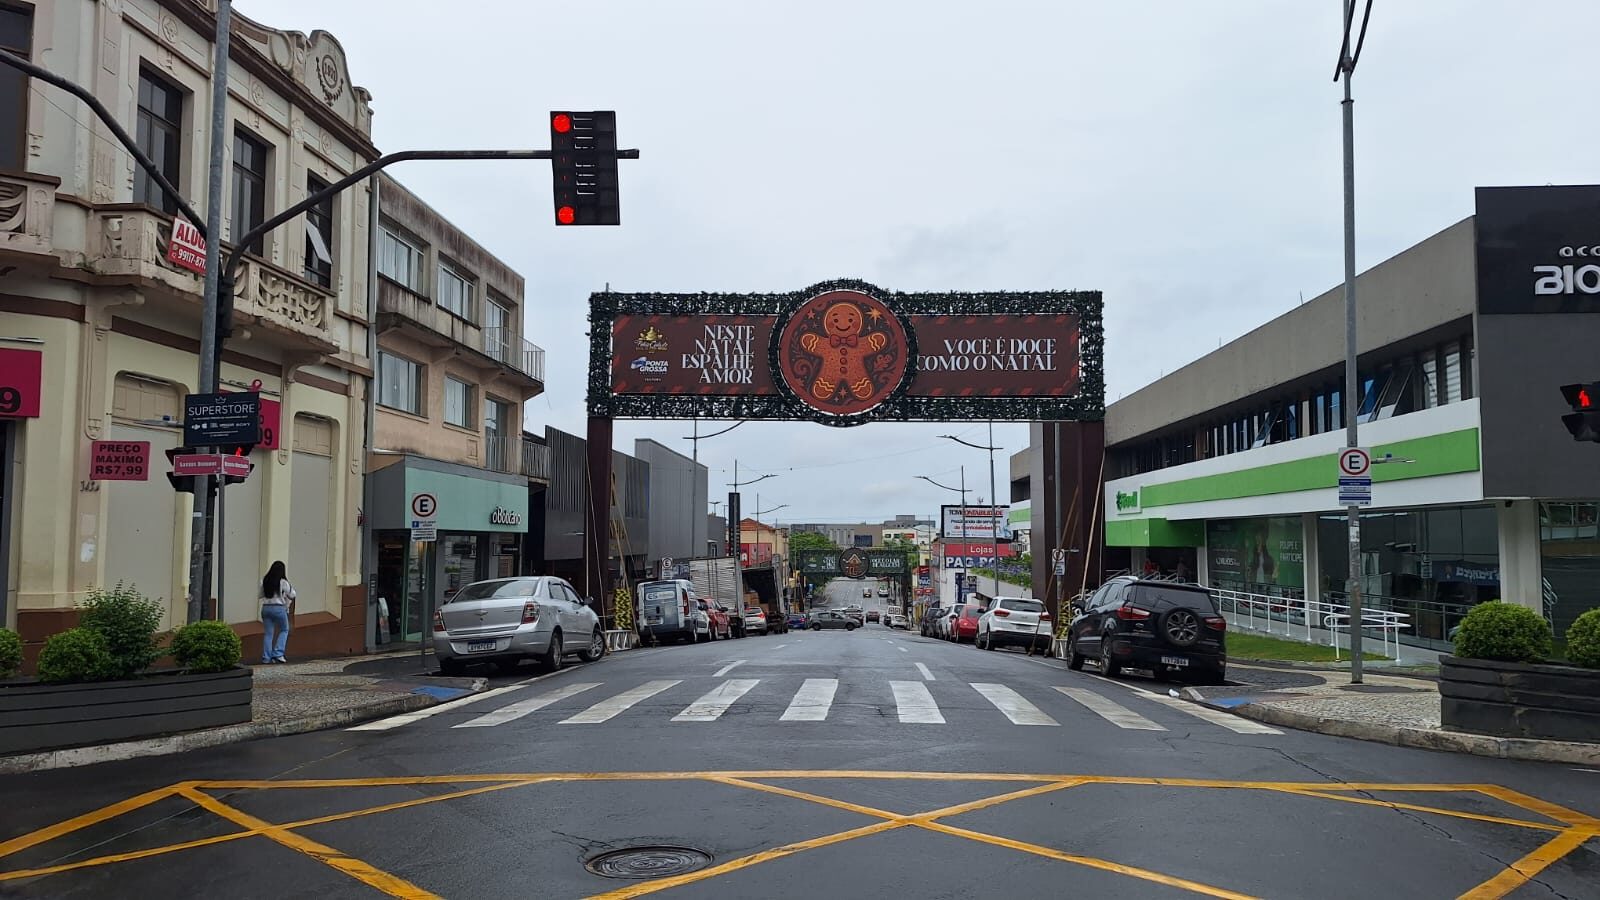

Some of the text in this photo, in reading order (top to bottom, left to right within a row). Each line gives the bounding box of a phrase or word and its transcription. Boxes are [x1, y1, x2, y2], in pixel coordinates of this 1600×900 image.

[176, 224, 206, 251] ALUG
[704, 325, 755, 340] NESTE
[695, 340, 755, 354] NATAL
[996, 336, 1006, 354] É
[1010, 339, 1057, 354] DOCE
[682, 354, 754, 369] ESPALHE
[917, 354, 1057, 371] COMO O NATAL
[699, 368, 753, 384] AMOR
[188, 403, 255, 416] SUPERSTORE
[99, 444, 141, 454] PREÇO
[1348, 455, 1361, 469] E
[95, 466, 143, 476] R$7,99
[420, 499, 429, 512] E
[970, 545, 993, 555] Lojas
[945, 556, 974, 568] PAG
